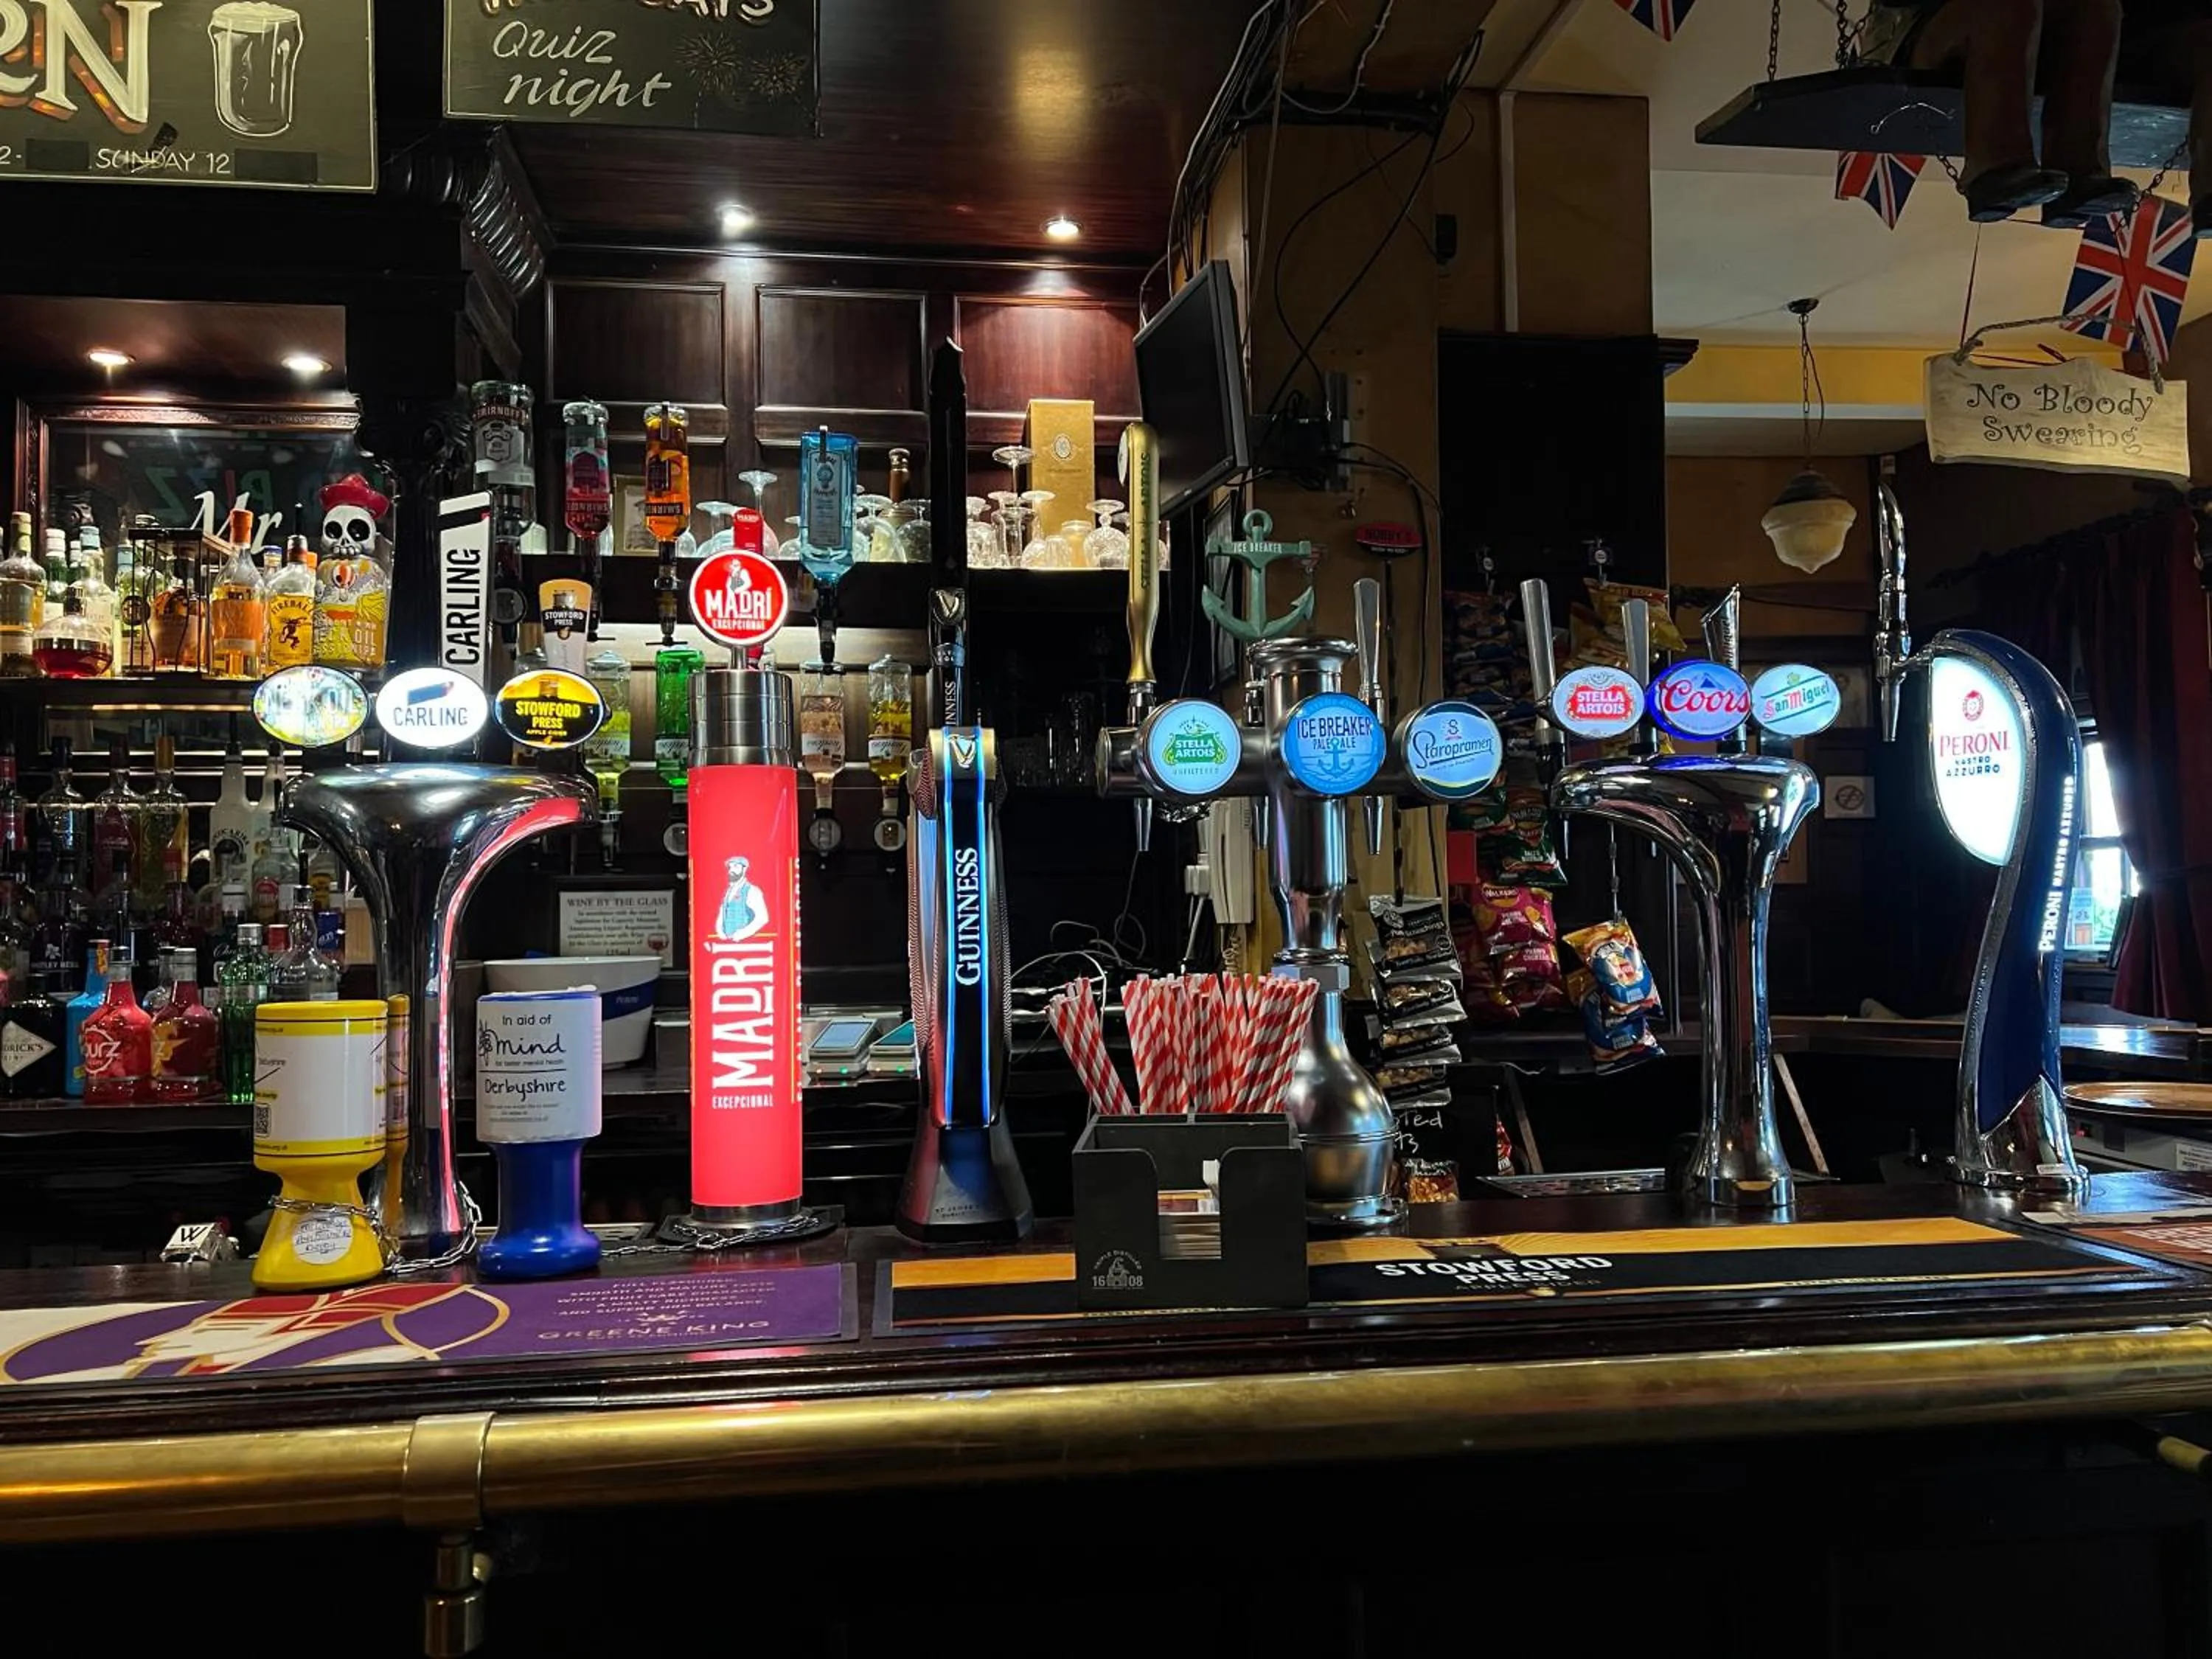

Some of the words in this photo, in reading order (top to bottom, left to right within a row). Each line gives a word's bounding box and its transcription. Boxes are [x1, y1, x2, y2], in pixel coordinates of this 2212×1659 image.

[493, 21, 617, 63] Quiz
[504, 68, 672, 117] night
[96, 147, 195, 173] SUNDAY
[206, 153, 231, 174] 12
[1967, 383, 2021, 411] No
[2034, 383, 2153, 421] Bloody
[1983, 415, 2142, 453] Swearing
[190, 490, 283, 555] Mr
[1234, 542, 1247, 553] ICE
[1250, 543, 1283, 554] BREAKER
[445, 548, 480, 664] CARLING
[544, 610, 584, 621] STOWFORD
[554, 618, 574, 626] PRESS
[712, 619, 765, 630] EXCEPCIONAL
[945, 680, 956, 726] INNESS
[1577, 691, 1624, 703] STELLA
[1659, 679, 1751, 714] Coors
[1763, 695, 1790, 719] San
[1782, 684, 1830, 710] Miguel
[393, 707, 468, 726] CARLING
[515, 700, 581, 717] STOWFORD
[1576, 703, 1625, 714] ARTOIS
[532, 716, 563, 728] PRESS
[1298, 718, 1315, 738] ICE
[1319, 717, 1371, 737] BREAKER
[1175, 740, 1214, 748] STELLA
[1313, 739, 1330, 749] PALE
[1340, 737, 1356, 748] ALE
[1413, 730, 1495, 768] Staropramen
[1940, 731, 2011, 757] PERONI
[1175, 748, 1215, 758] ARTOIS
[1955, 757, 1991, 765] NASTRO
[1947, 765, 2000, 776] AZZURRO
[955, 847, 981, 986] GUINNESS
[2038, 891, 2063, 952] PERONI
[503, 1015, 512, 1026] In
[517, 1015, 535, 1026] aid
[539, 1014, 552, 1025] of
[3, 1043, 44, 1052] DRICK'S
[484, 1079, 567, 1102] Derbyshire
[712, 1093, 774, 1109] EXCEPCIONAL
[181, 1227, 208, 1242] W
[1374, 1256, 1613, 1276] STOWFORD
[1092, 1275, 1106, 1287] 16
[1128, 1275, 1144, 1287] 08
[1455, 1270, 1571, 1284] PRESS
[538, 1326, 672, 1340] GREENE
[686, 1321, 770, 1332] KING
